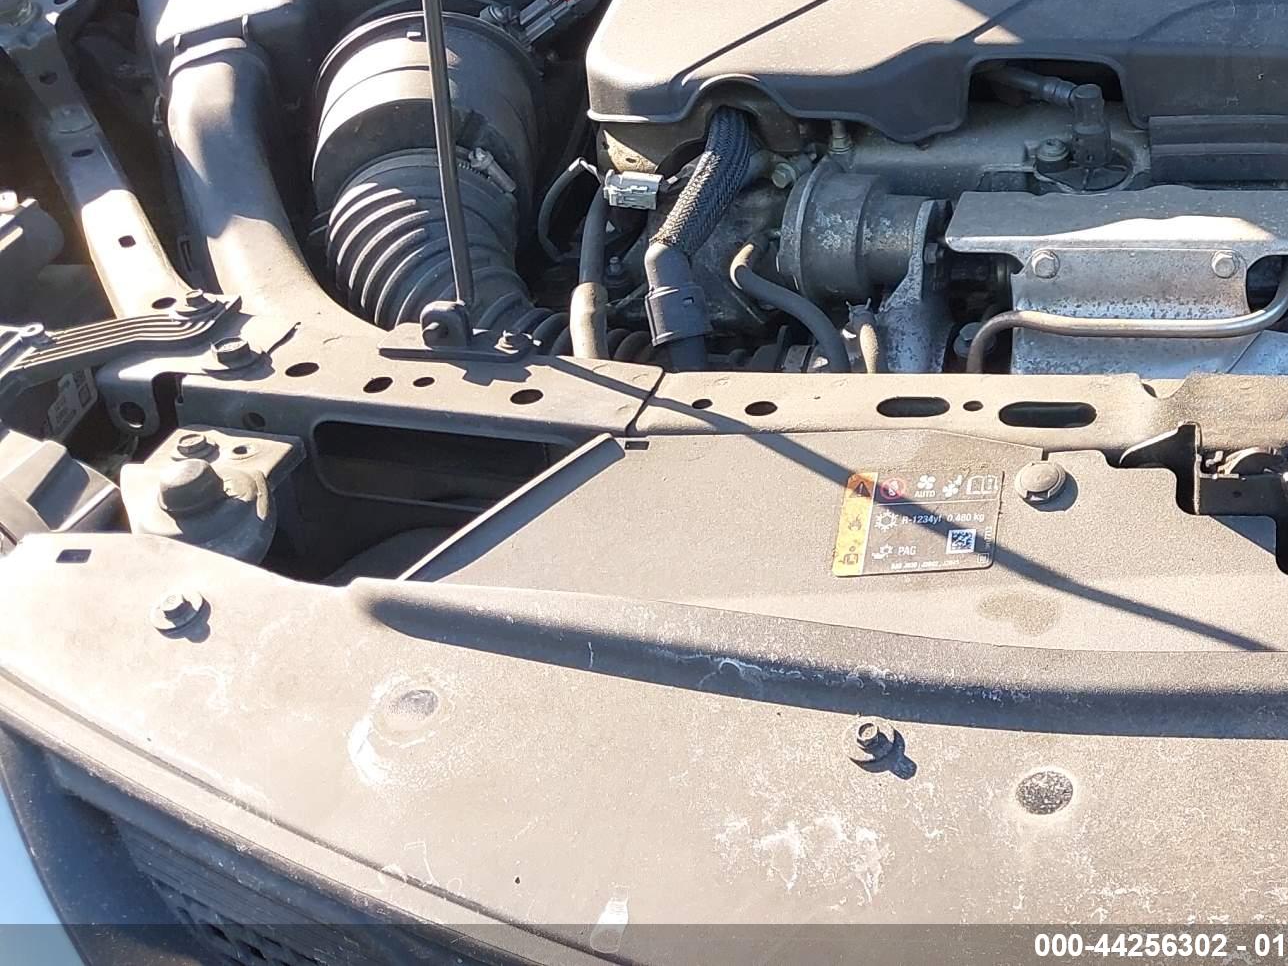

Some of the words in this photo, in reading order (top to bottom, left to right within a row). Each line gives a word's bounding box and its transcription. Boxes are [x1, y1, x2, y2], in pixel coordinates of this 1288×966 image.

[914, 490, 936, 498] AUTO
[973, 512, 985, 524] kg
[897, 545, 917, 556] PAG
